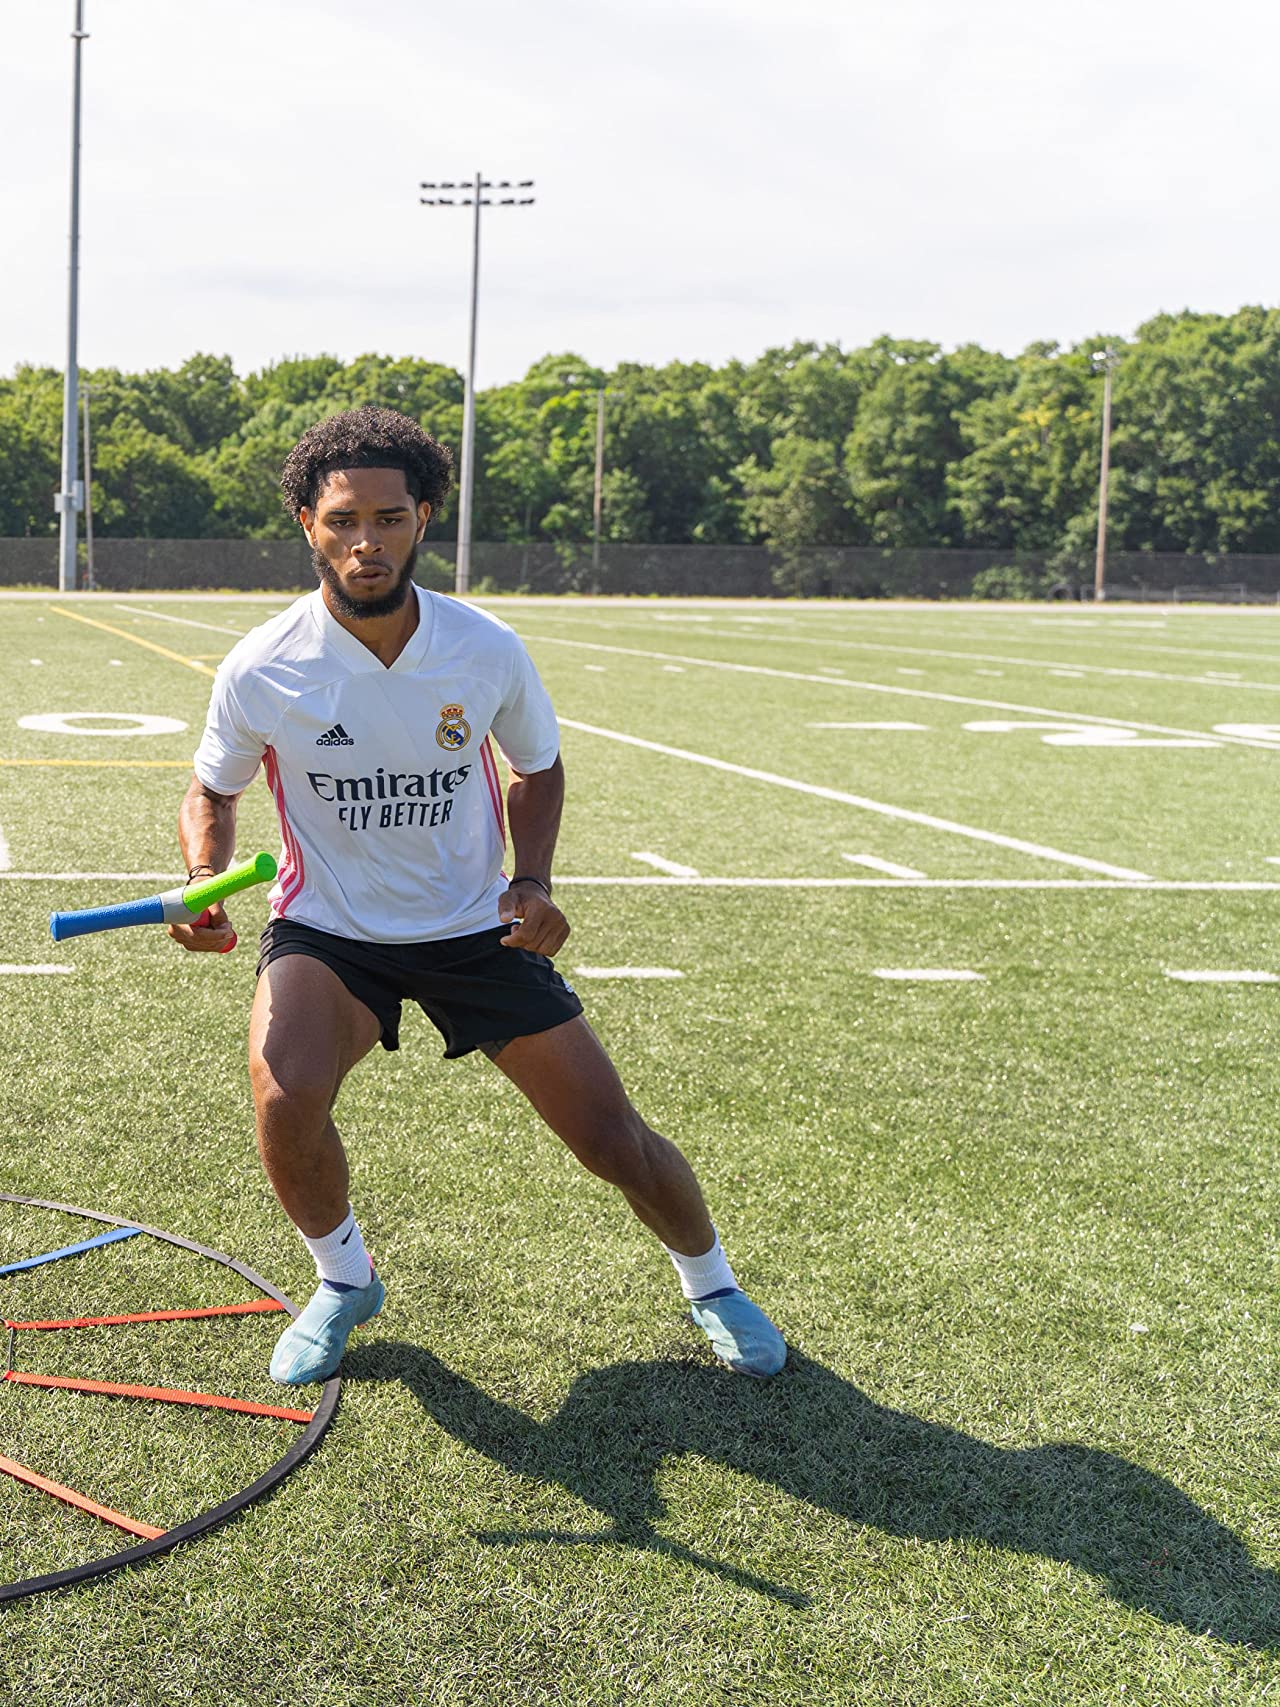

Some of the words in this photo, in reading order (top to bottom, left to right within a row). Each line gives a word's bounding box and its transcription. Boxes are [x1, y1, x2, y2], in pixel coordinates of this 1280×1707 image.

[316, 736, 355, 747] adidas
[305, 764, 472, 802] Emirates
[338, 805, 372, 831] FLY
[379, 799, 454, 828] BETTER
